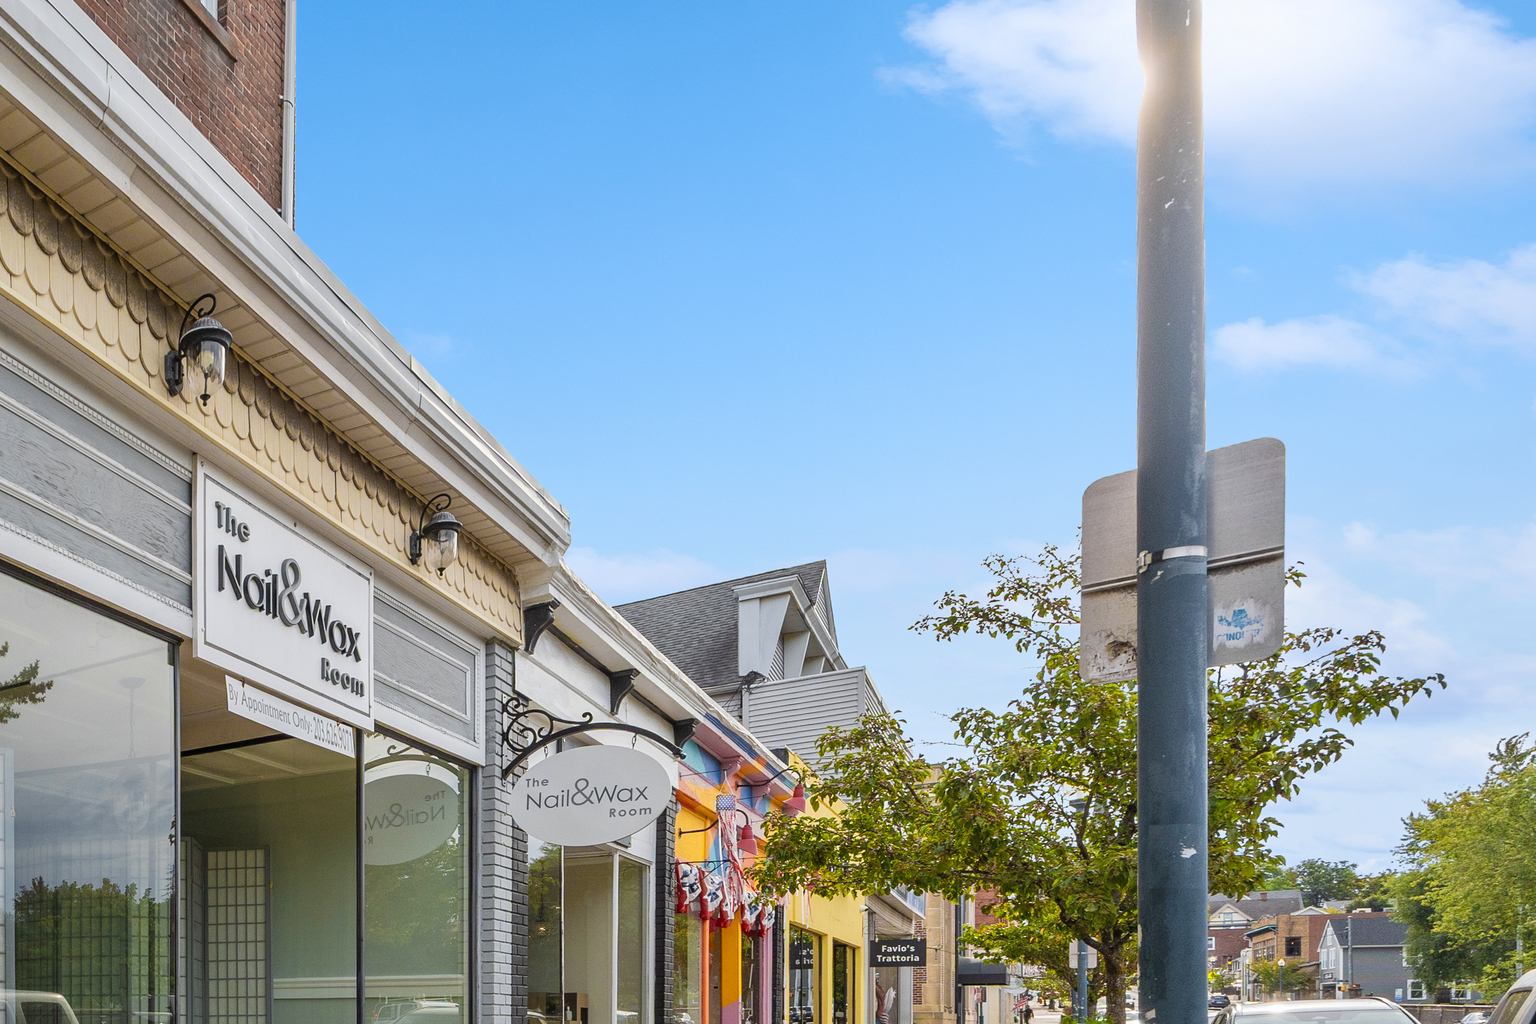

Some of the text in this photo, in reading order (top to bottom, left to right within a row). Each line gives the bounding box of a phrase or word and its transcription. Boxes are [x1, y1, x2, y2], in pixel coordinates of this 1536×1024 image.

[215, 501, 250, 542] The
[218, 545, 361, 662] Nail&Wax
[321, 657, 364, 697] Room
[228, 684, 238, 705] By
[242, 690, 290, 724] Appointment
[292, 712, 312, 735] Only:
[526, 778, 549, 788] The
[526, 778, 648, 810] Nail&Wax
[610, 806, 652, 818] Room
[876, 954, 920, 962] Trattoria
[882, 944, 916, 952] Favio's
